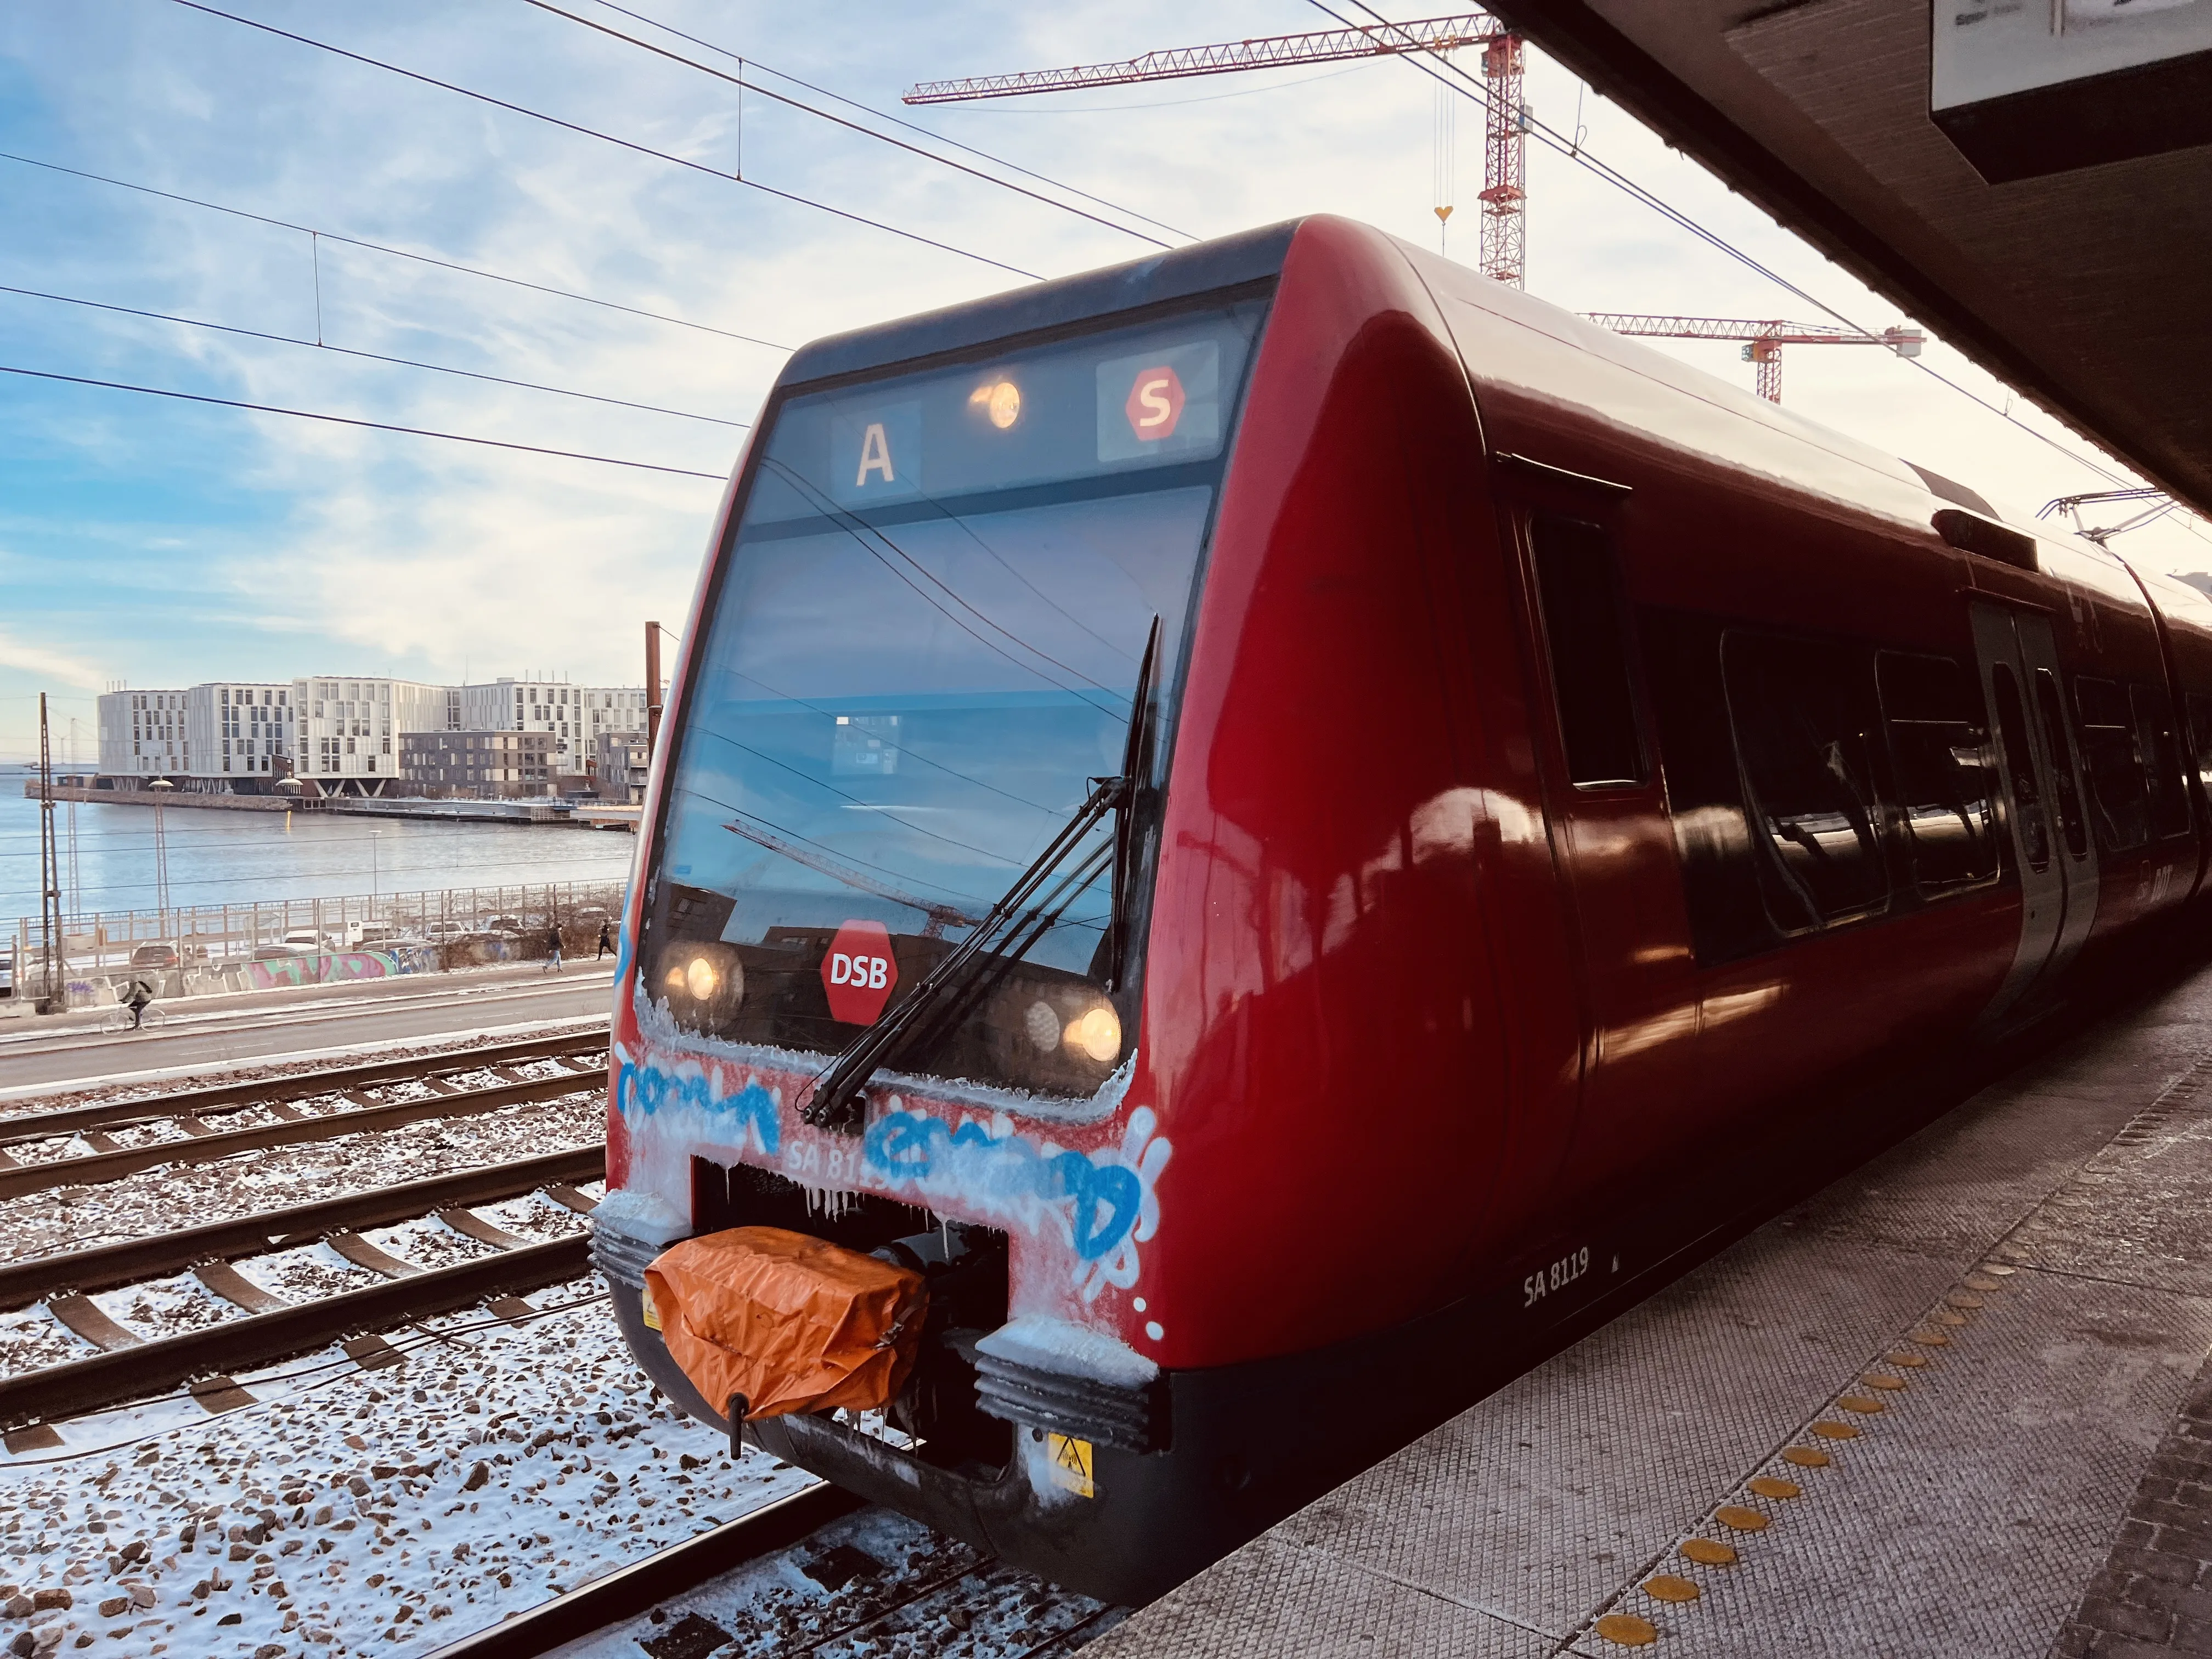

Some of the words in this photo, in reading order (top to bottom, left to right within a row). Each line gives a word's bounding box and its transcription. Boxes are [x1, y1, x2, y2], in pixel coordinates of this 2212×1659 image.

[1139, 380, 1171, 427] S
[856, 424, 894, 487] A
[831, 952, 888, 990] DSB
[788, 1141, 820, 1176] SA
[1523, 1270, 1547, 1308] SA
[1550, 1246, 1589, 1291] 8119
